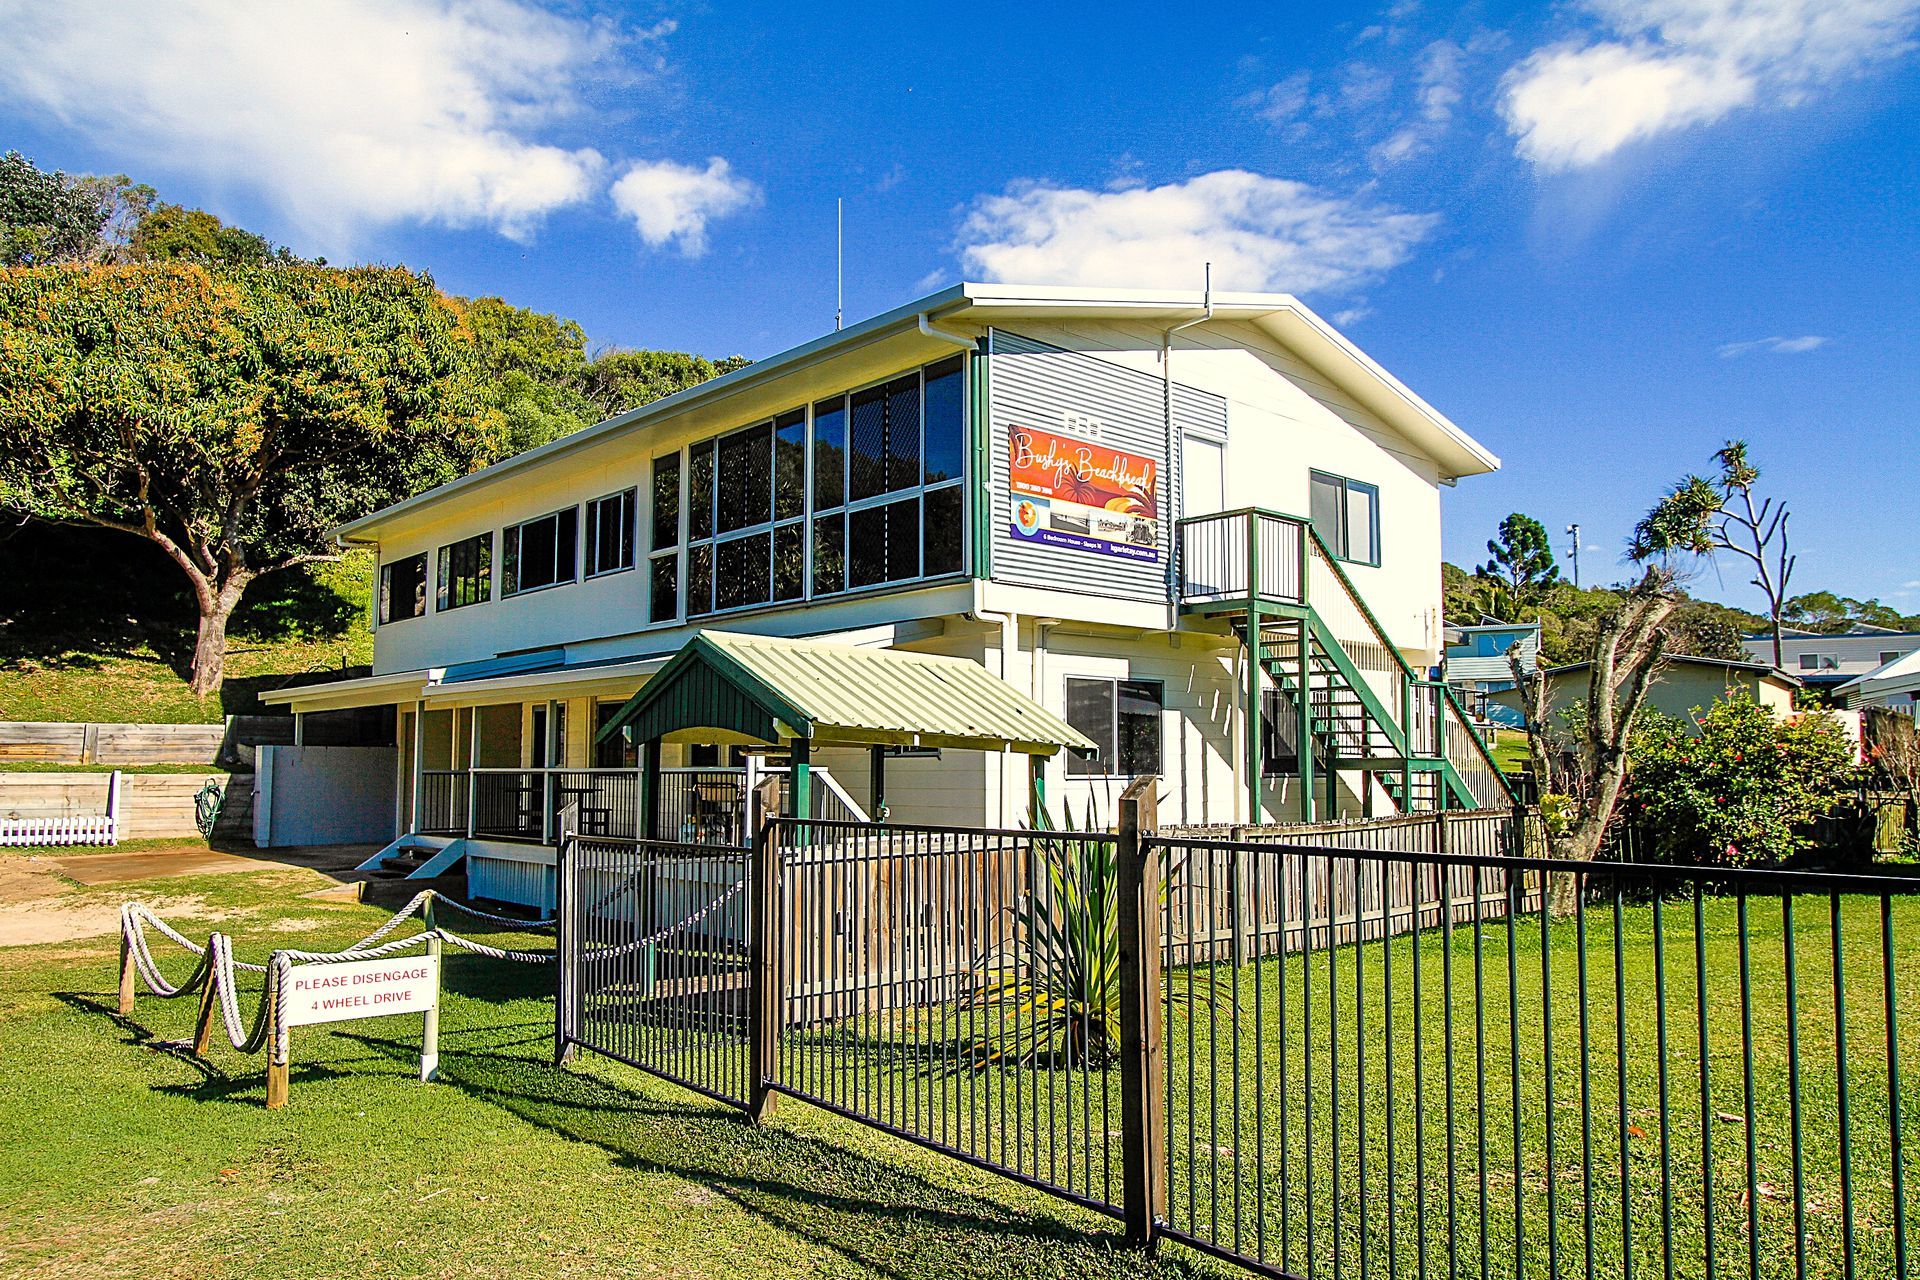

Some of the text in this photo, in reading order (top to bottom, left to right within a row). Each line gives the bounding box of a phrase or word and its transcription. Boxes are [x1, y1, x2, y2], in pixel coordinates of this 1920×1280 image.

[1015, 433, 1151, 489] Bushy's Beachbreak
[1047, 534, 1067, 543] Bedroom
[1067, 538, 1081, 546] House
[295, 968, 429, 991] PLEASE DISENGAGE
[311, 990, 413, 1011] 4 WHEEL DRIVE
